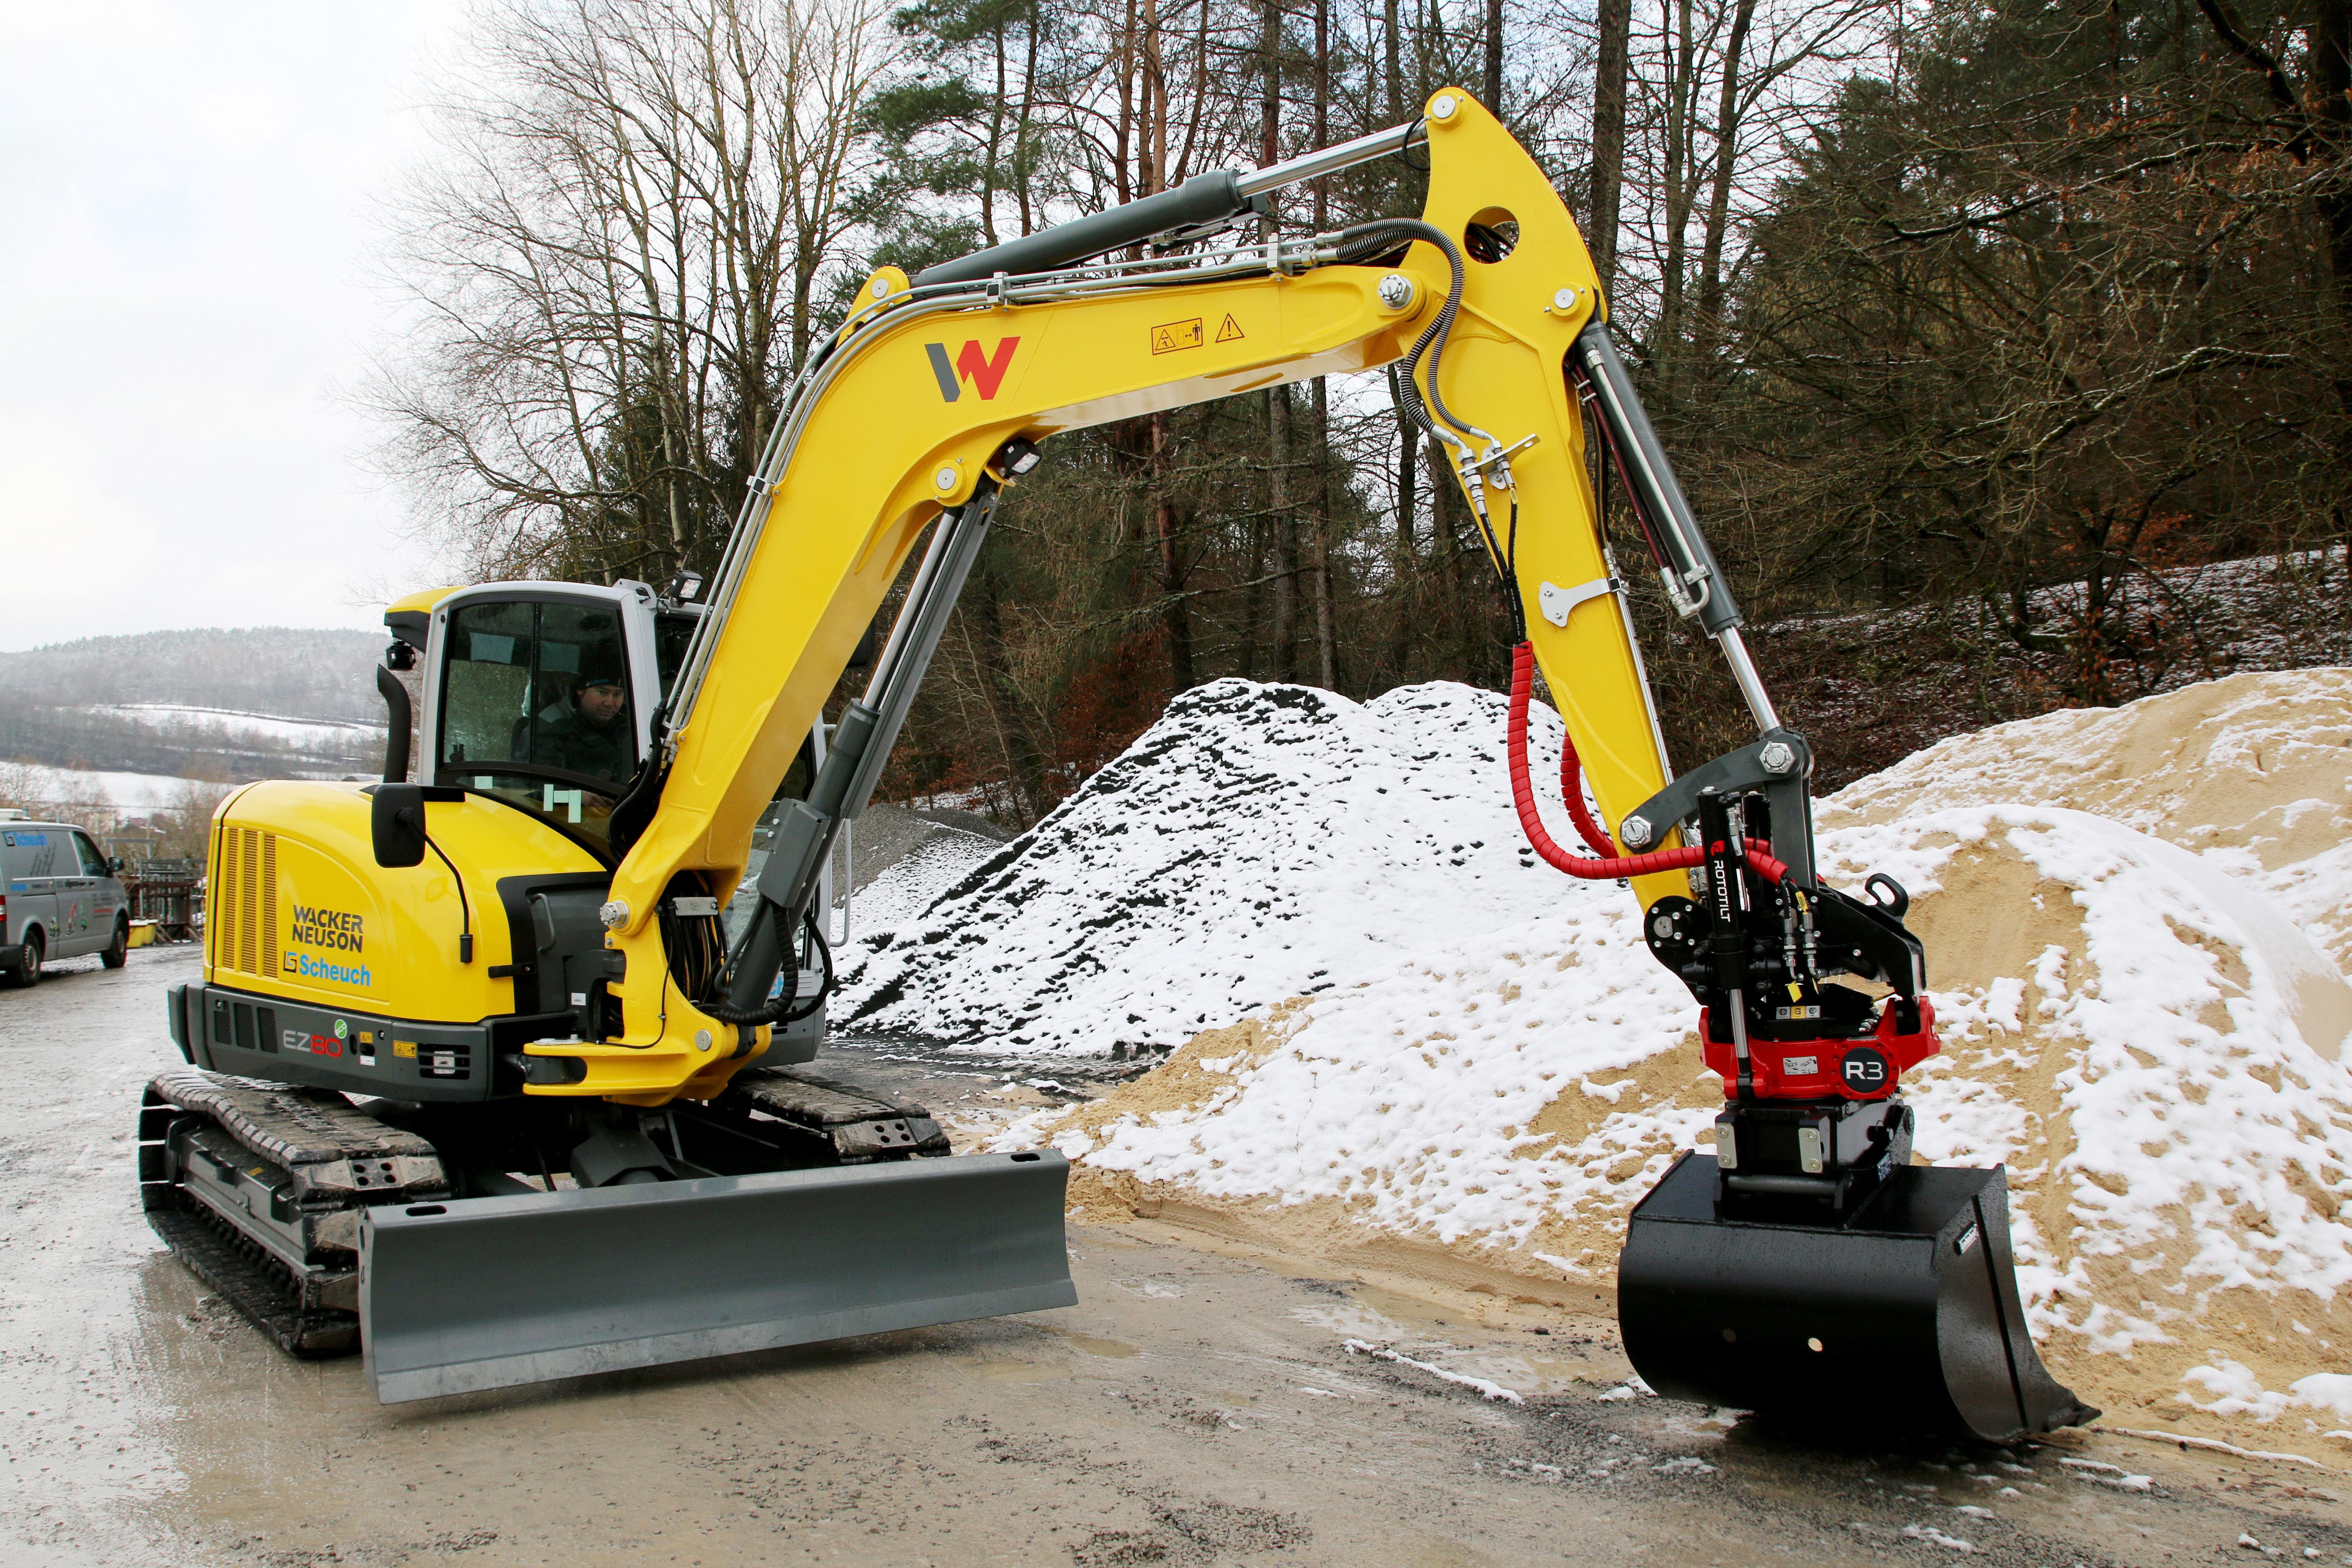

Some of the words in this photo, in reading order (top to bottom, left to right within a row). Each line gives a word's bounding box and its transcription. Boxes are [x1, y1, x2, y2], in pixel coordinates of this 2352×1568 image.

[925, 337, 1021, 402] W
[1714, 860, 1731, 922] ROTOTILT
[293, 904, 364, 934] WACKER
[292, 924, 363, 953] NEUSON
[300, 954, 371, 986] Scheuch
[283, 1030, 343, 1057] EZ80
[1846, 1061, 1883, 1080] R3
